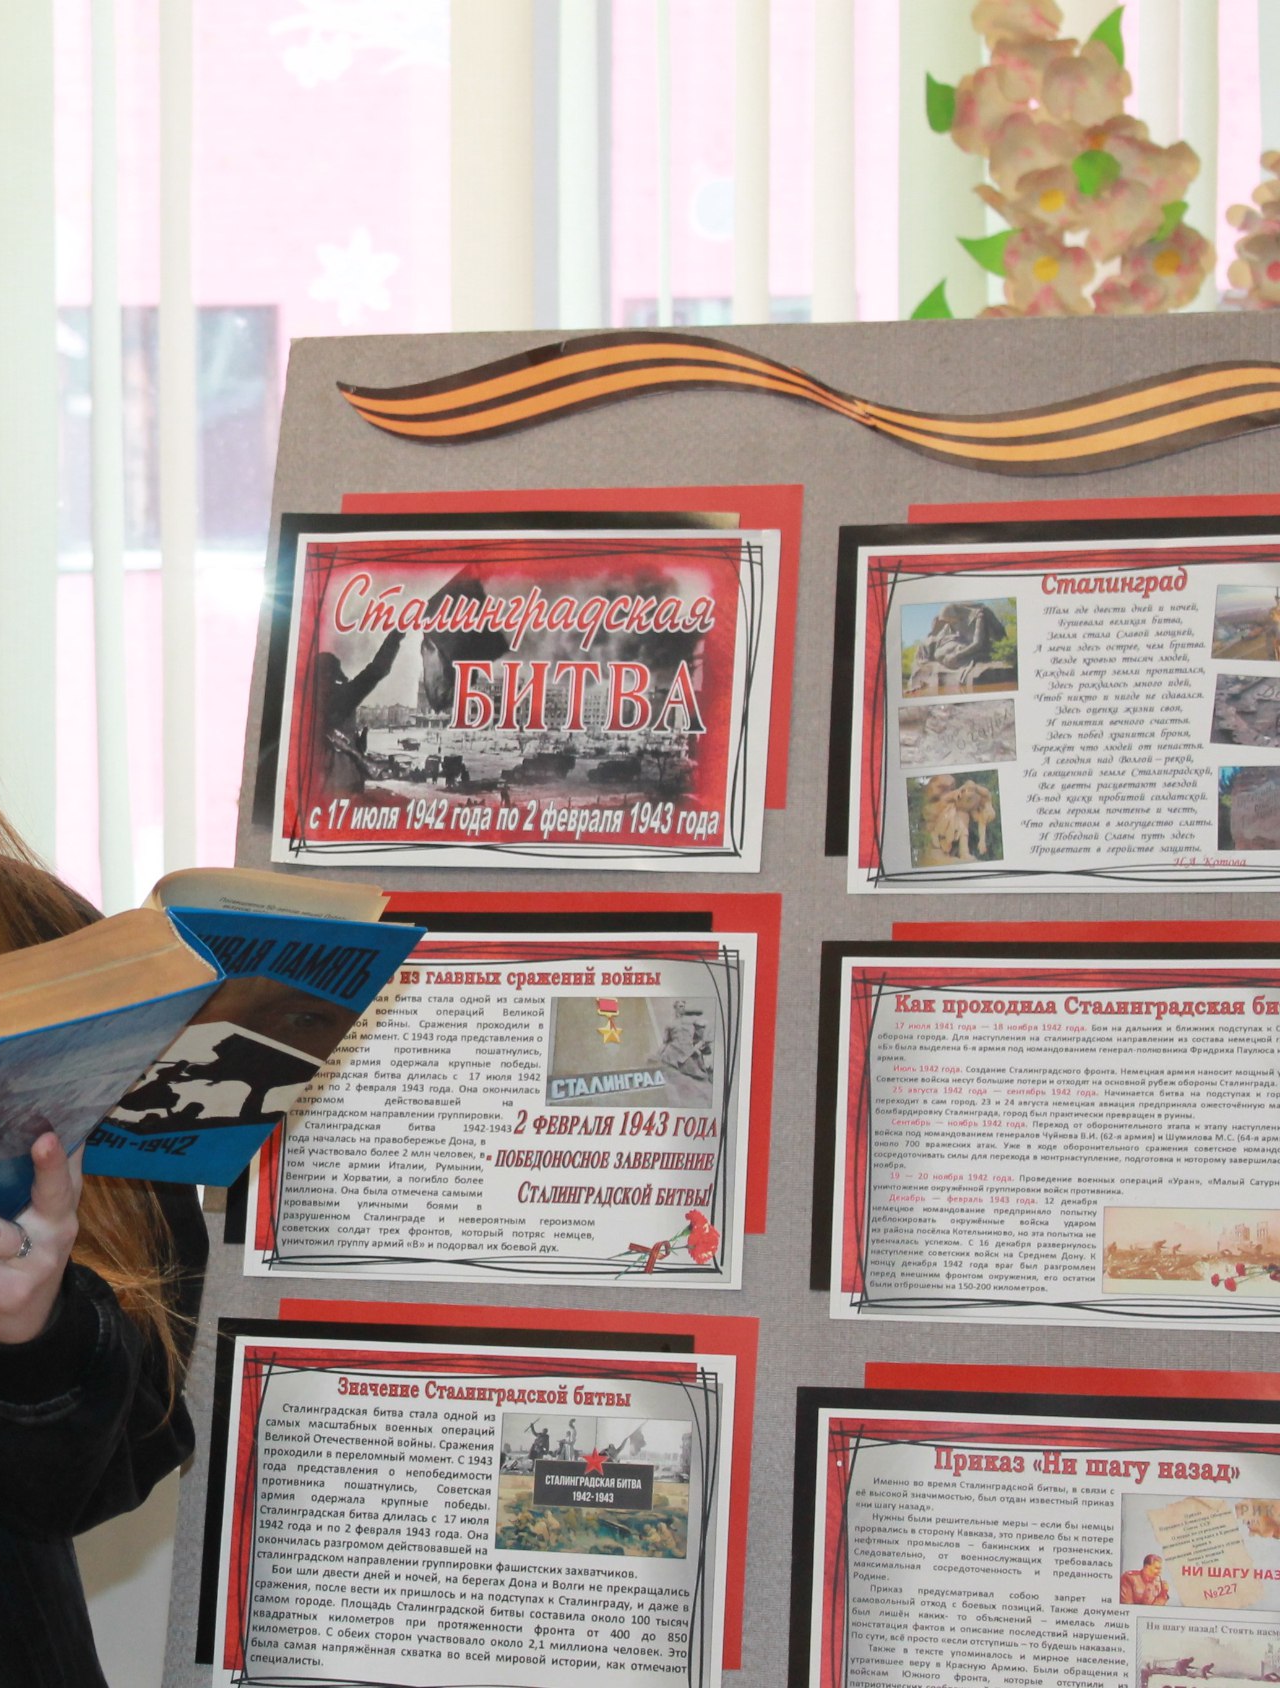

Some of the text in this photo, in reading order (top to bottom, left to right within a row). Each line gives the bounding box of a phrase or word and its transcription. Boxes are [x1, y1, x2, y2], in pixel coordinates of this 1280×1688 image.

[1041, 567, 1188, 598] Сталинград
[335, 572, 715, 651] Сталинградская
[449, 661, 706, 734] БИТВА
[328, 800, 347, 829] 17
[350, 806, 398, 830] июля
[405, 800, 449, 830] 1942
[451, 808, 492, 832] года
[497, 811, 518, 831] по
[522, 803, 536, 831] 2
[540, 805, 623, 840] февраля
[630, 803, 671, 834] 1943
[677, 809, 718, 836] года
[269, 941, 380, 999] ПАМЯТЬ
[399, 970, 420, 984] из
[425, 971, 501, 985] главных
[506, 967, 595, 989] сражений
[600, 967, 661, 985] войны
[393, 992, 422, 1002] битва
[427, 995, 454, 1003] стала
[459, 994, 490, 1005] одной
[512, 996, 545, 1004] самых
[894, 994, 935, 1012] Как
[941, 999, 1057, 1018] проходила
[1063, 995, 1245, 1020] Сталинградская
[350, 1059, 541, 1070] армия одержала крупные победы.
[551, 1070, 666, 1099] СТАЛИНГРАД
[289, 1108, 503, 1121] сталинградском направлении группировки.
[304, 1120, 512, 1134] Сталинградская битва 1942-1943
[513, 1110, 717, 1140] 2 ФЕВРАЛЯ 1943 ГОДА
[87, 1129, 200, 1155] 941-1942
[494, 1150, 609, 1171] ПОБЕДОНОСНОЕ
[614, 1152, 714, 1171] ЗАВЕРШЕНИЕ
[281, 1238, 334, 1246] уничтожил
[337, 1239, 369, 1248] группу
[371, 1238, 404, 1248] армий
[406, 1239, 424, 1248] «В»
[436, 1241, 483, 1251] подорвал
[500, 1241, 536, 1251] боевой
[538, 1244, 559, 1253] дух.
[869, 1279, 892, 1288] были
[893, 1280, 943, 1289] отброшены
[958, 1282, 991, 1290] 150-200
[993, 1284, 1047, 1292] километров.
[337, 1376, 631, 1407] Значение Сталинградской битвы
[282, 1402, 495, 1422] Сталинградская битва стала одной из
[265, 1418, 495, 1437] самых масштабных военных операций
[264, 1431, 494, 1451] Великой Отечественной войны. Сражения
[933, 1448, 1240, 1484] Приказ «Ни шагу назад»
[261, 1477, 491, 1495] противника пошатнулись, Советская
[545, 1475, 642, 1489] СТАЛИНГРАДСКАЯ БИТВА
[873, 1477, 909, 1486] Именно
[927, 1480, 956, 1488] время
[959, 1480, 1033, 1492] Сталинградской
[1036, 1483, 1068, 1494] битвы,
[573, 1491, 614, 1503] 1942-1943
[257, 1550, 637, 1578] сталинградском направлении группировки фашистских захватчиков.
[1181, 1565, 1280, 1580] НИ ШАГУ НАЗ
[1203, 1584, 1239, 1601] №227
[252, 1624, 688, 1660] километров. С обеих сторон участвовало около 2,1 миллиона человек. Это
[1256, 1629, 1280, 1638] насм
[249, 1654, 323, 1666] специалисты.
[250, 1636, 687, 1675] была самая напряжённая схватка во всей мировой истории, как отмечают
